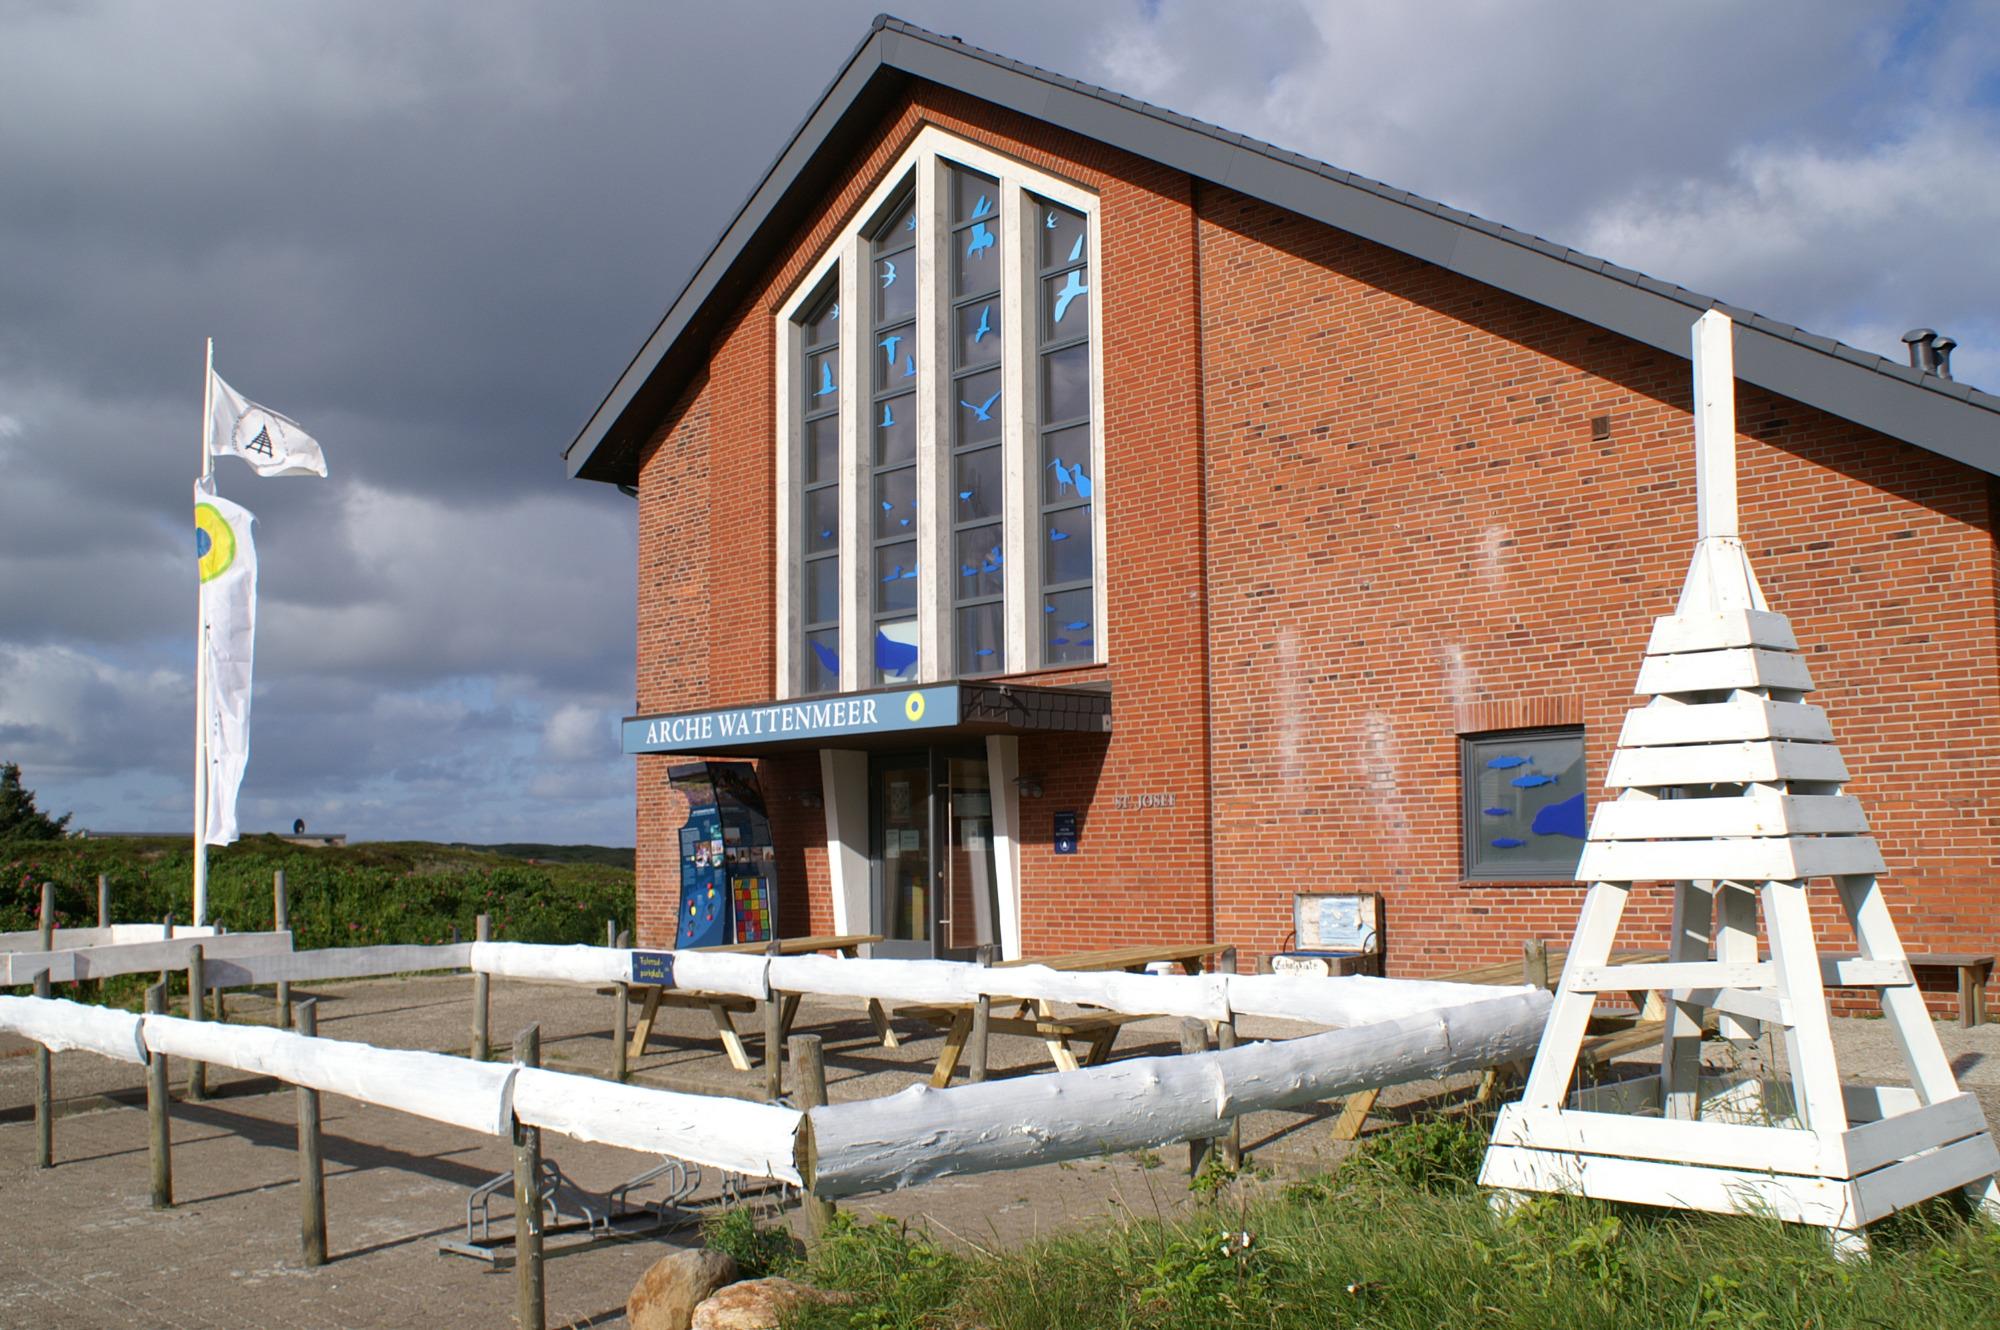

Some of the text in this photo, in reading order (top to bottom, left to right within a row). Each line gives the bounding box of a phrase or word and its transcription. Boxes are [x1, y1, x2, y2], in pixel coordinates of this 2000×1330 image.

[646, 699, 878, 744] ARCHE WATTENMEER
[1137, 793, 1176, 811] JOSEF
